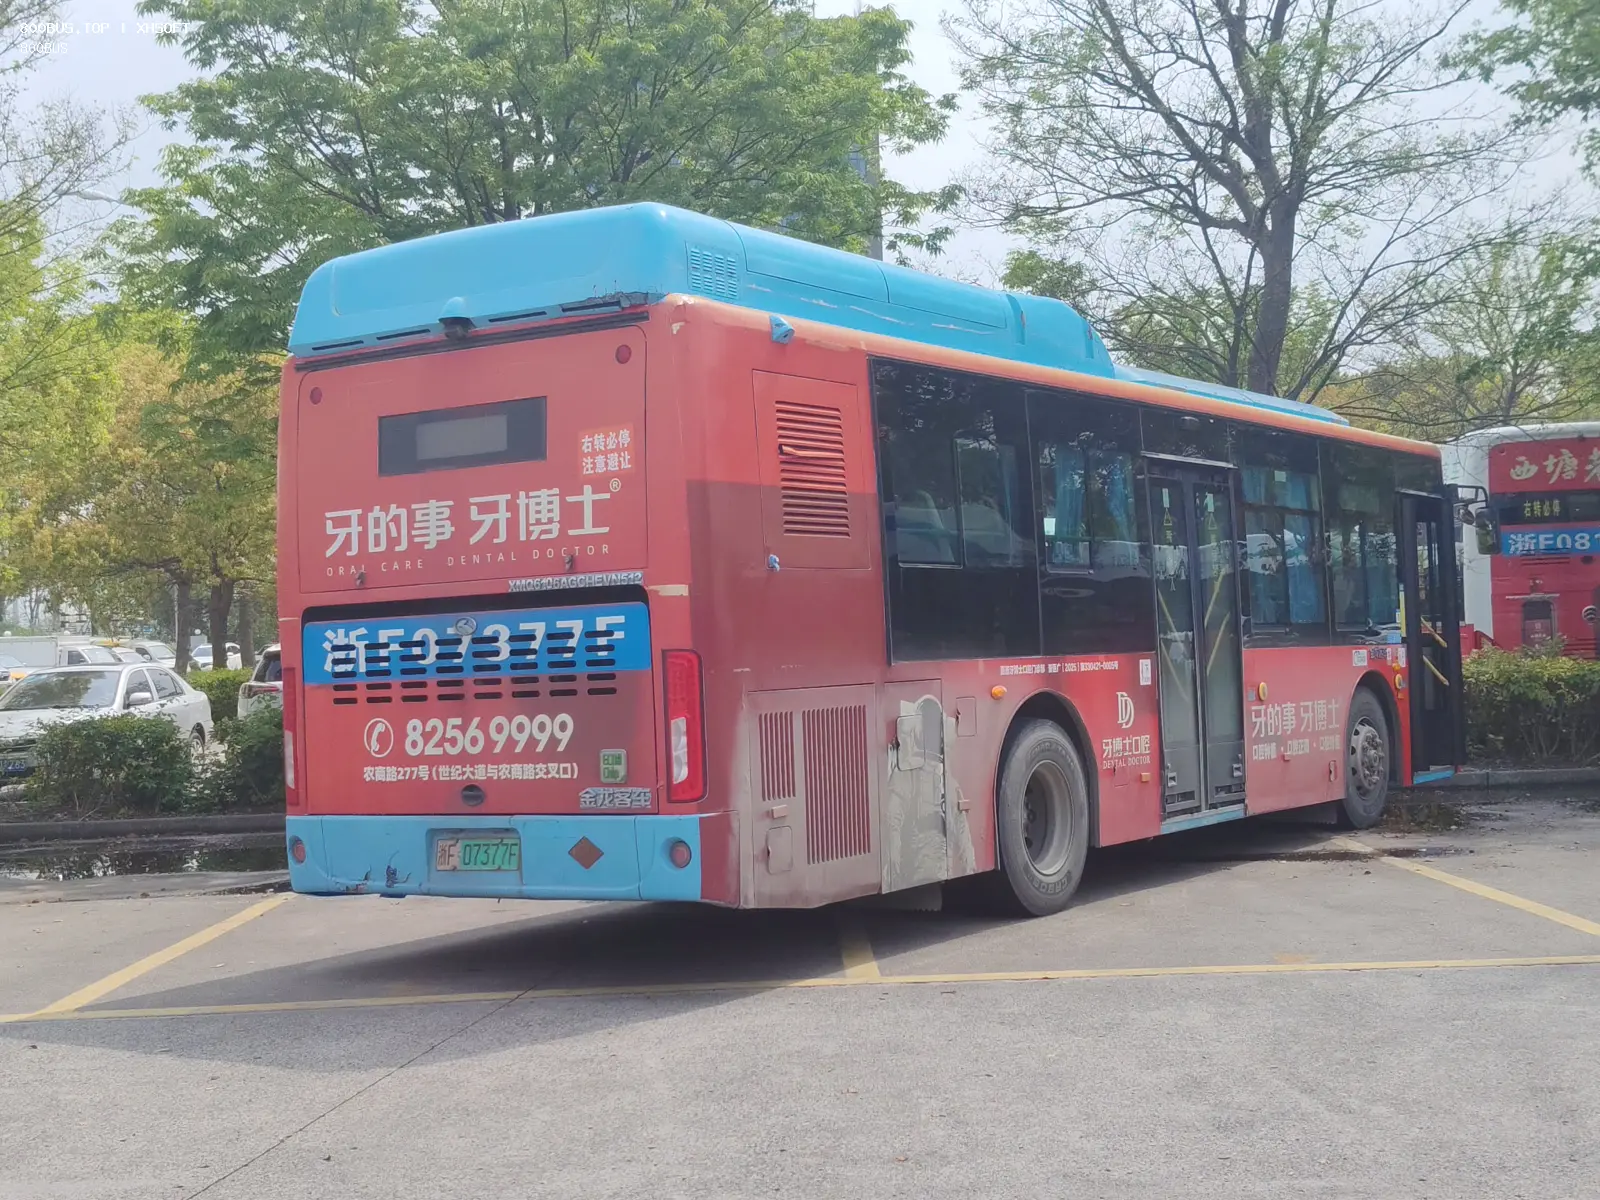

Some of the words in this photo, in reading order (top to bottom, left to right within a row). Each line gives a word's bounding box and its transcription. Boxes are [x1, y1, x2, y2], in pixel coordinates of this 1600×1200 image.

[581, 428, 631, 453] 右转必停
[582, 450, 632, 475] 注意避让
[1523, 498, 1561, 518] 右转必停
[324, 499, 456, 558] 牙的事
[469, 484, 611, 545] 牙博士
[1507, 531, 1600, 555] 浙F08
[326, 564, 367, 577] ORAL
[381, 559, 424, 573] CARE
[447, 551, 517, 567] DENTAL
[532, 544, 610, 560] DOCTOR
[1251, 702, 1297, 738] 牙的事
[1300, 698, 1341, 733] 牙博士
[1102, 734, 1151, 759] 牙博士口腔
[1102, 757, 1127, 770] DENTAL
[1127, 755, 1151, 767] DOCTOR
[578, 787, 652, 809] 金龙客车
